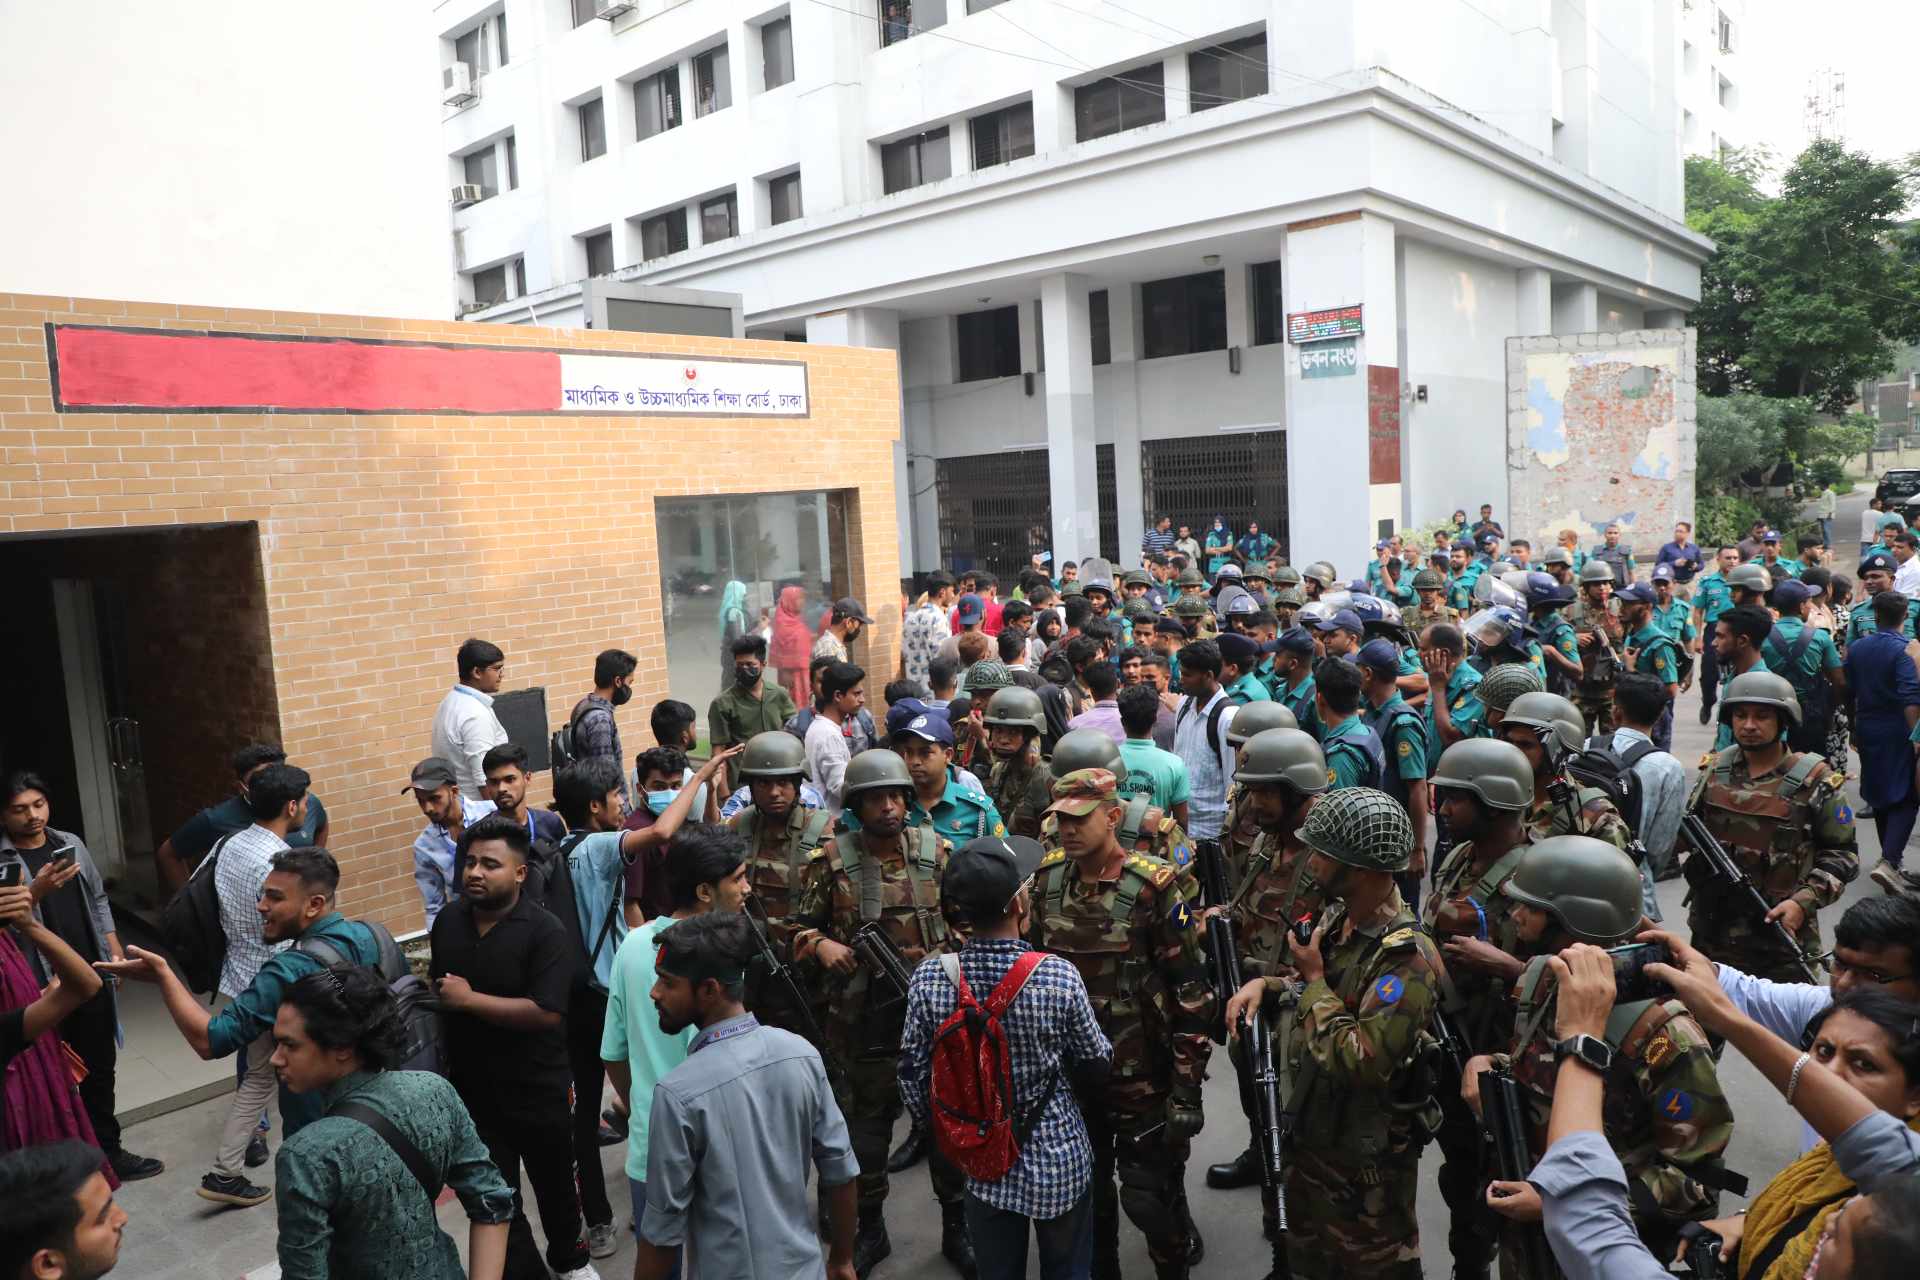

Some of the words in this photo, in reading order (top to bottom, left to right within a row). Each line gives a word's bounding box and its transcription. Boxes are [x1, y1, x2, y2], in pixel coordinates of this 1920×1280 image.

[1301, 350, 1328, 369] ভবন
[565, 385, 619, 406] মাধ্যমিক
[625, 391, 634, 404] ও
[638, 386, 709, 407] উচ্চমাধ্যমিক
[713, 388, 741, 408] শিক্ষা
[779, 394, 802, 408] ঢাকা
